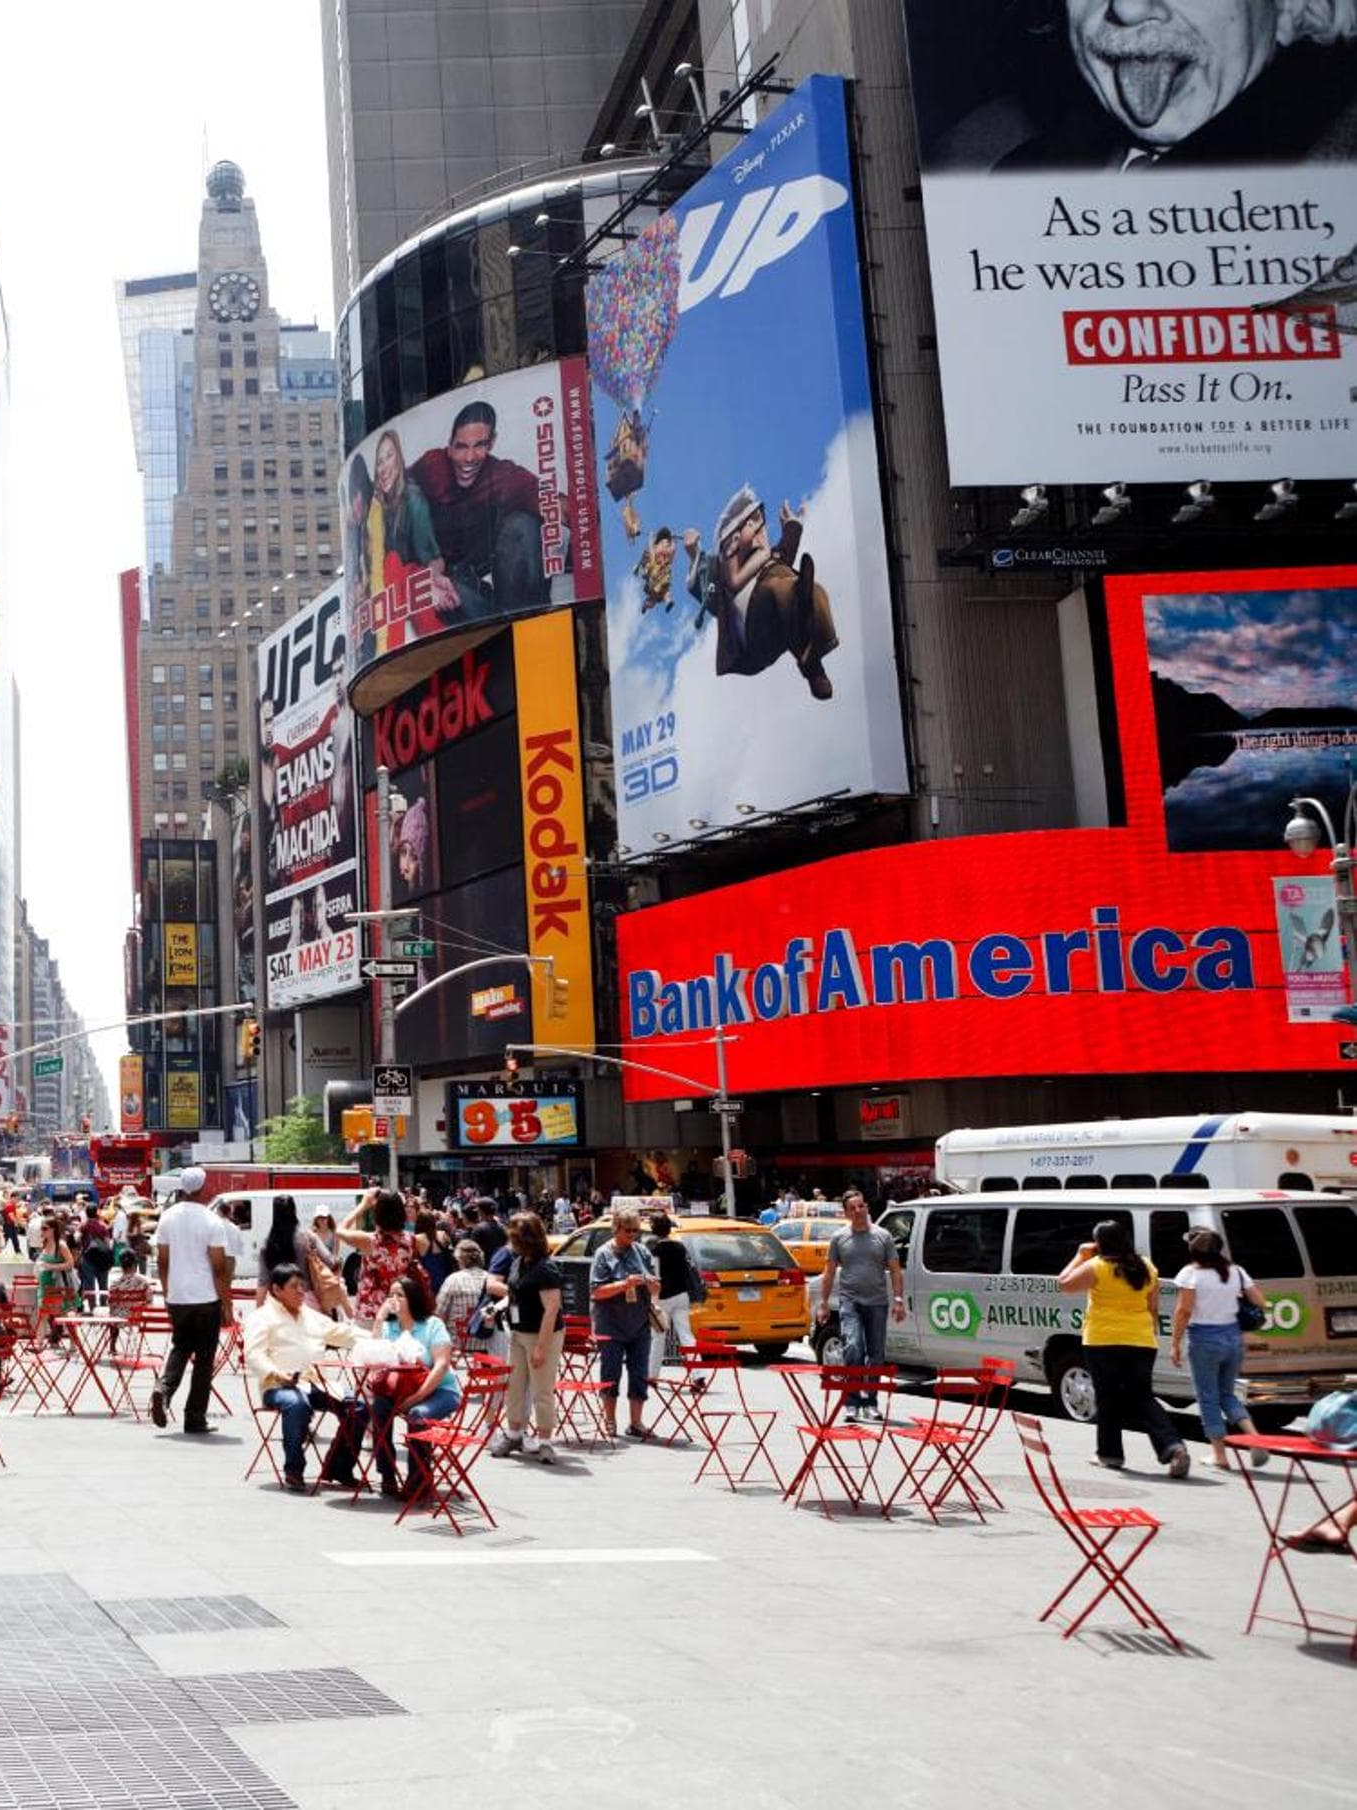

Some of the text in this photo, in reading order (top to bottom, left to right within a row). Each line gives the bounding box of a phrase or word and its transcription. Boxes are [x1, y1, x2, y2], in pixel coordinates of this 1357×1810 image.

[733, 112, 805, 185] Disney PIXAR
[1042, 189, 1336, 240] As a student,
[678, 174, 849, 314] UP
[969, 243, 1342, 292] he was no Einst
[1073, 313, 1332, 358] CONFIDENCE
[1122, 370, 1293, 404] Pass It On.
[1077, 422, 1102, 435] THE
[1109, 421, 1203, 434] FOUNDATION
[1244, 420, 1253, 432] A
[1260, 418, 1312, 432] BETTER
[1319, 417, 1351, 431] LIFE
[262, 596, 346, 718] UFC
[373, 650, 493, 772] Kodak
[622, 710, 676, 757] MAY 29
[1232, 731, 1258, 750] The
[1261, 730, 1290, 752] right
[1293, 729, 1326, 750] thing
[275, 736, 335, 805] EVANS
[623, 754, 679, 803] 3D
[275, 805, 341, 871] MACHIDA
[524, 728, 582, 942] Kodak
[326, 892, 354, 919] SERRA
[169, 947, 193, 960] LION
[169, 962, 194, 977] KING
[269, 952, 294, 982] SAT.
[298, 939, 332, 974] MAY
[336, 931, 354, 963] 23
[393, 963, 411, 975] WAY
[628, 905, 1255, 1040] Bank of America
[463, 1101, 499, 1145] 9
[508, 1100, 543, 1143] 5
[930, 1296, 972, 1331] GO
[986, 1304, 1062, 1329] AIRLINK
